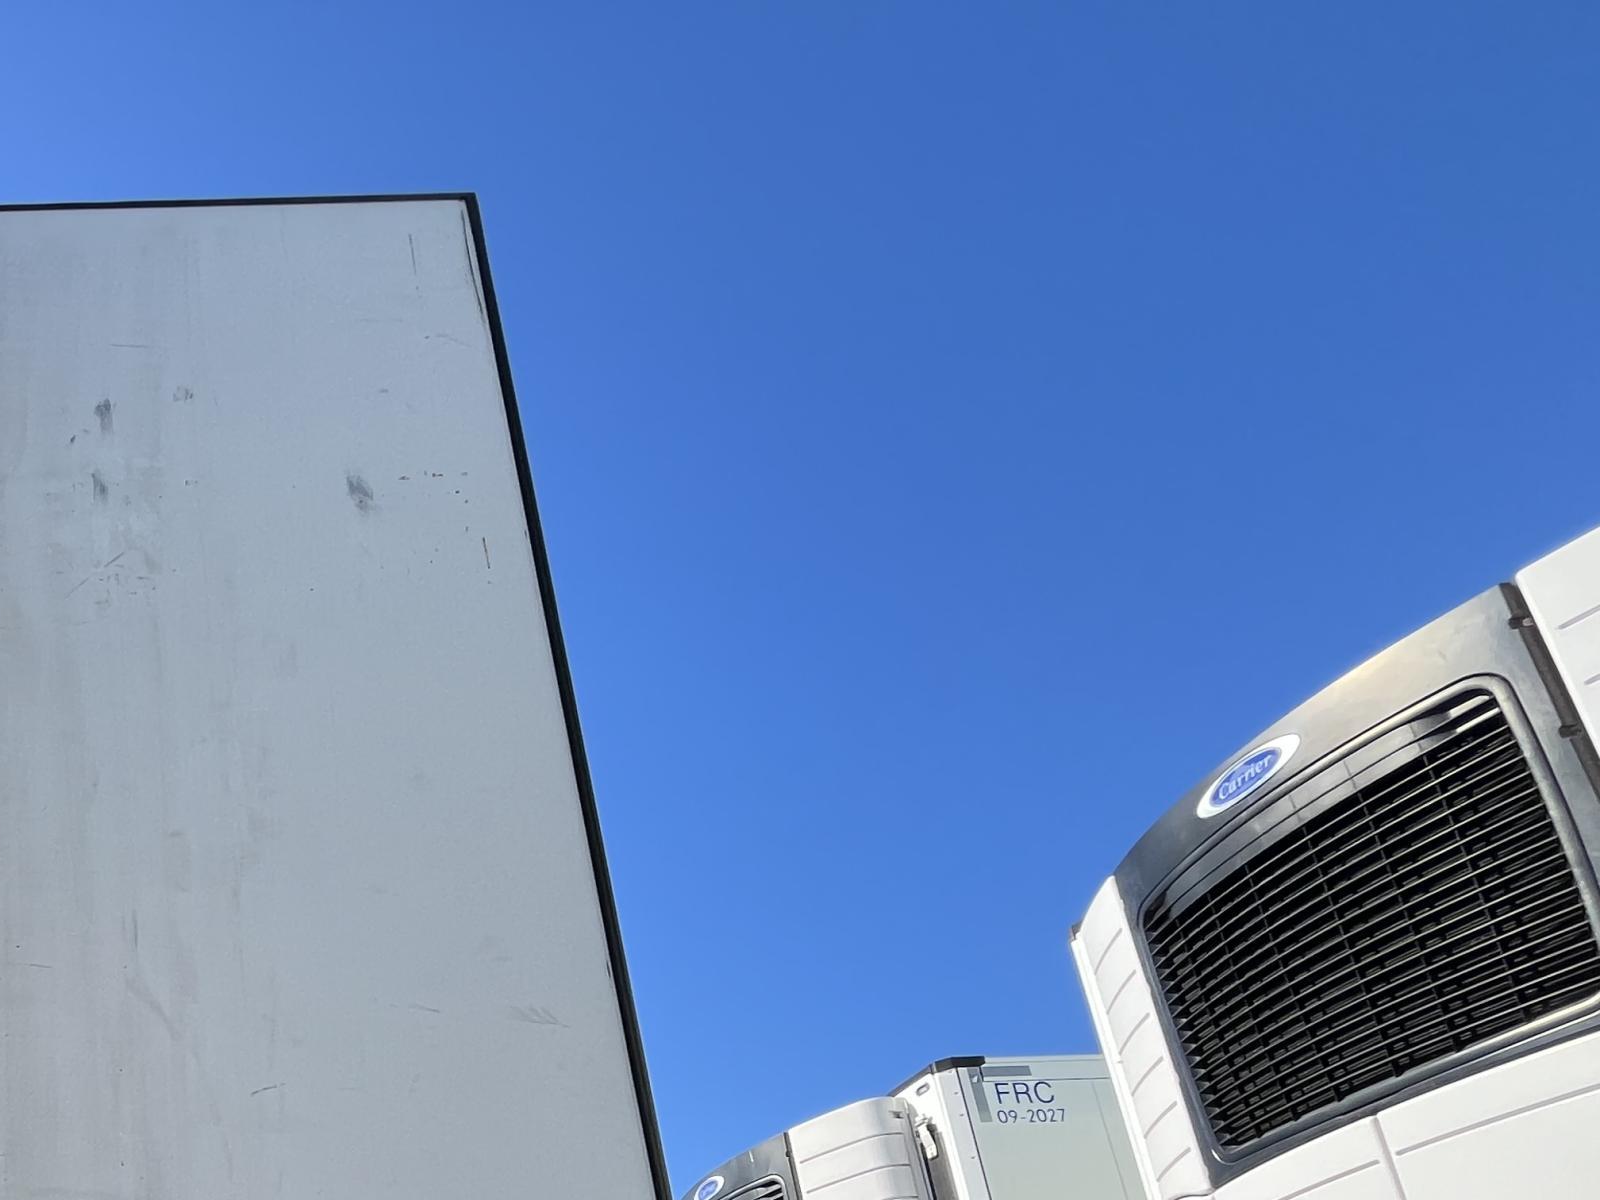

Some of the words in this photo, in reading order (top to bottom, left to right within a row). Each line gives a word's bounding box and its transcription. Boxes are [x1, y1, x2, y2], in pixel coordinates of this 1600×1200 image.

[1218, 753, 1273, 801] Carrier
[994, 1081, 1055, 1105] FRC
[996, 1108, 1066, 1124] 09-2027
